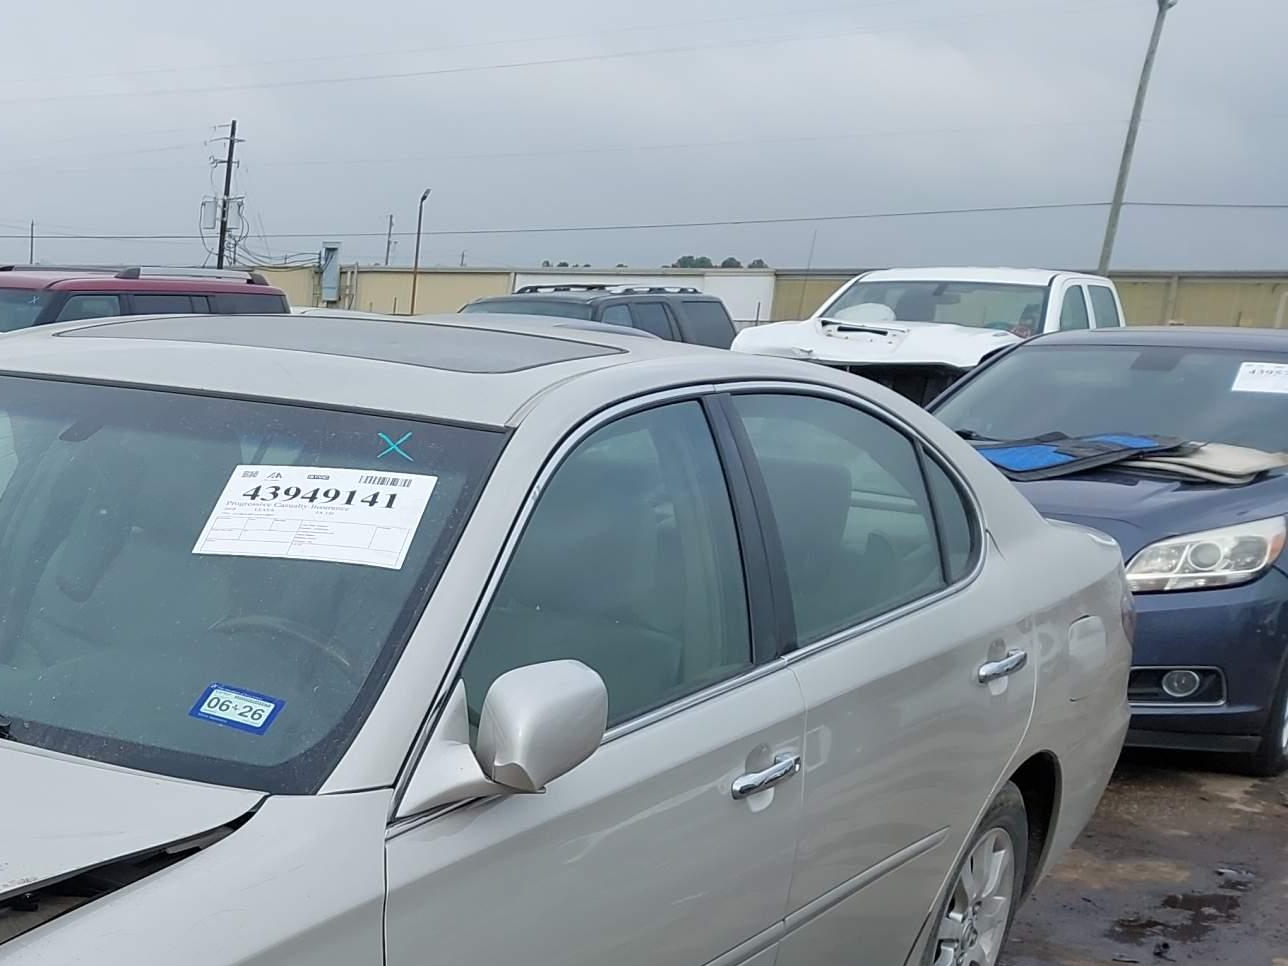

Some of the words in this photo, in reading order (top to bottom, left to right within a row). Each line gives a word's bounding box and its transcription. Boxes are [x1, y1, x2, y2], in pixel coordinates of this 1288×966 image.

[242, 484, 398, 509] 43949141
[225, 500, 272, 508] Progressive
[273, 502, 309, 511] Casualty
[310, 504, 350, 512] Insurance
